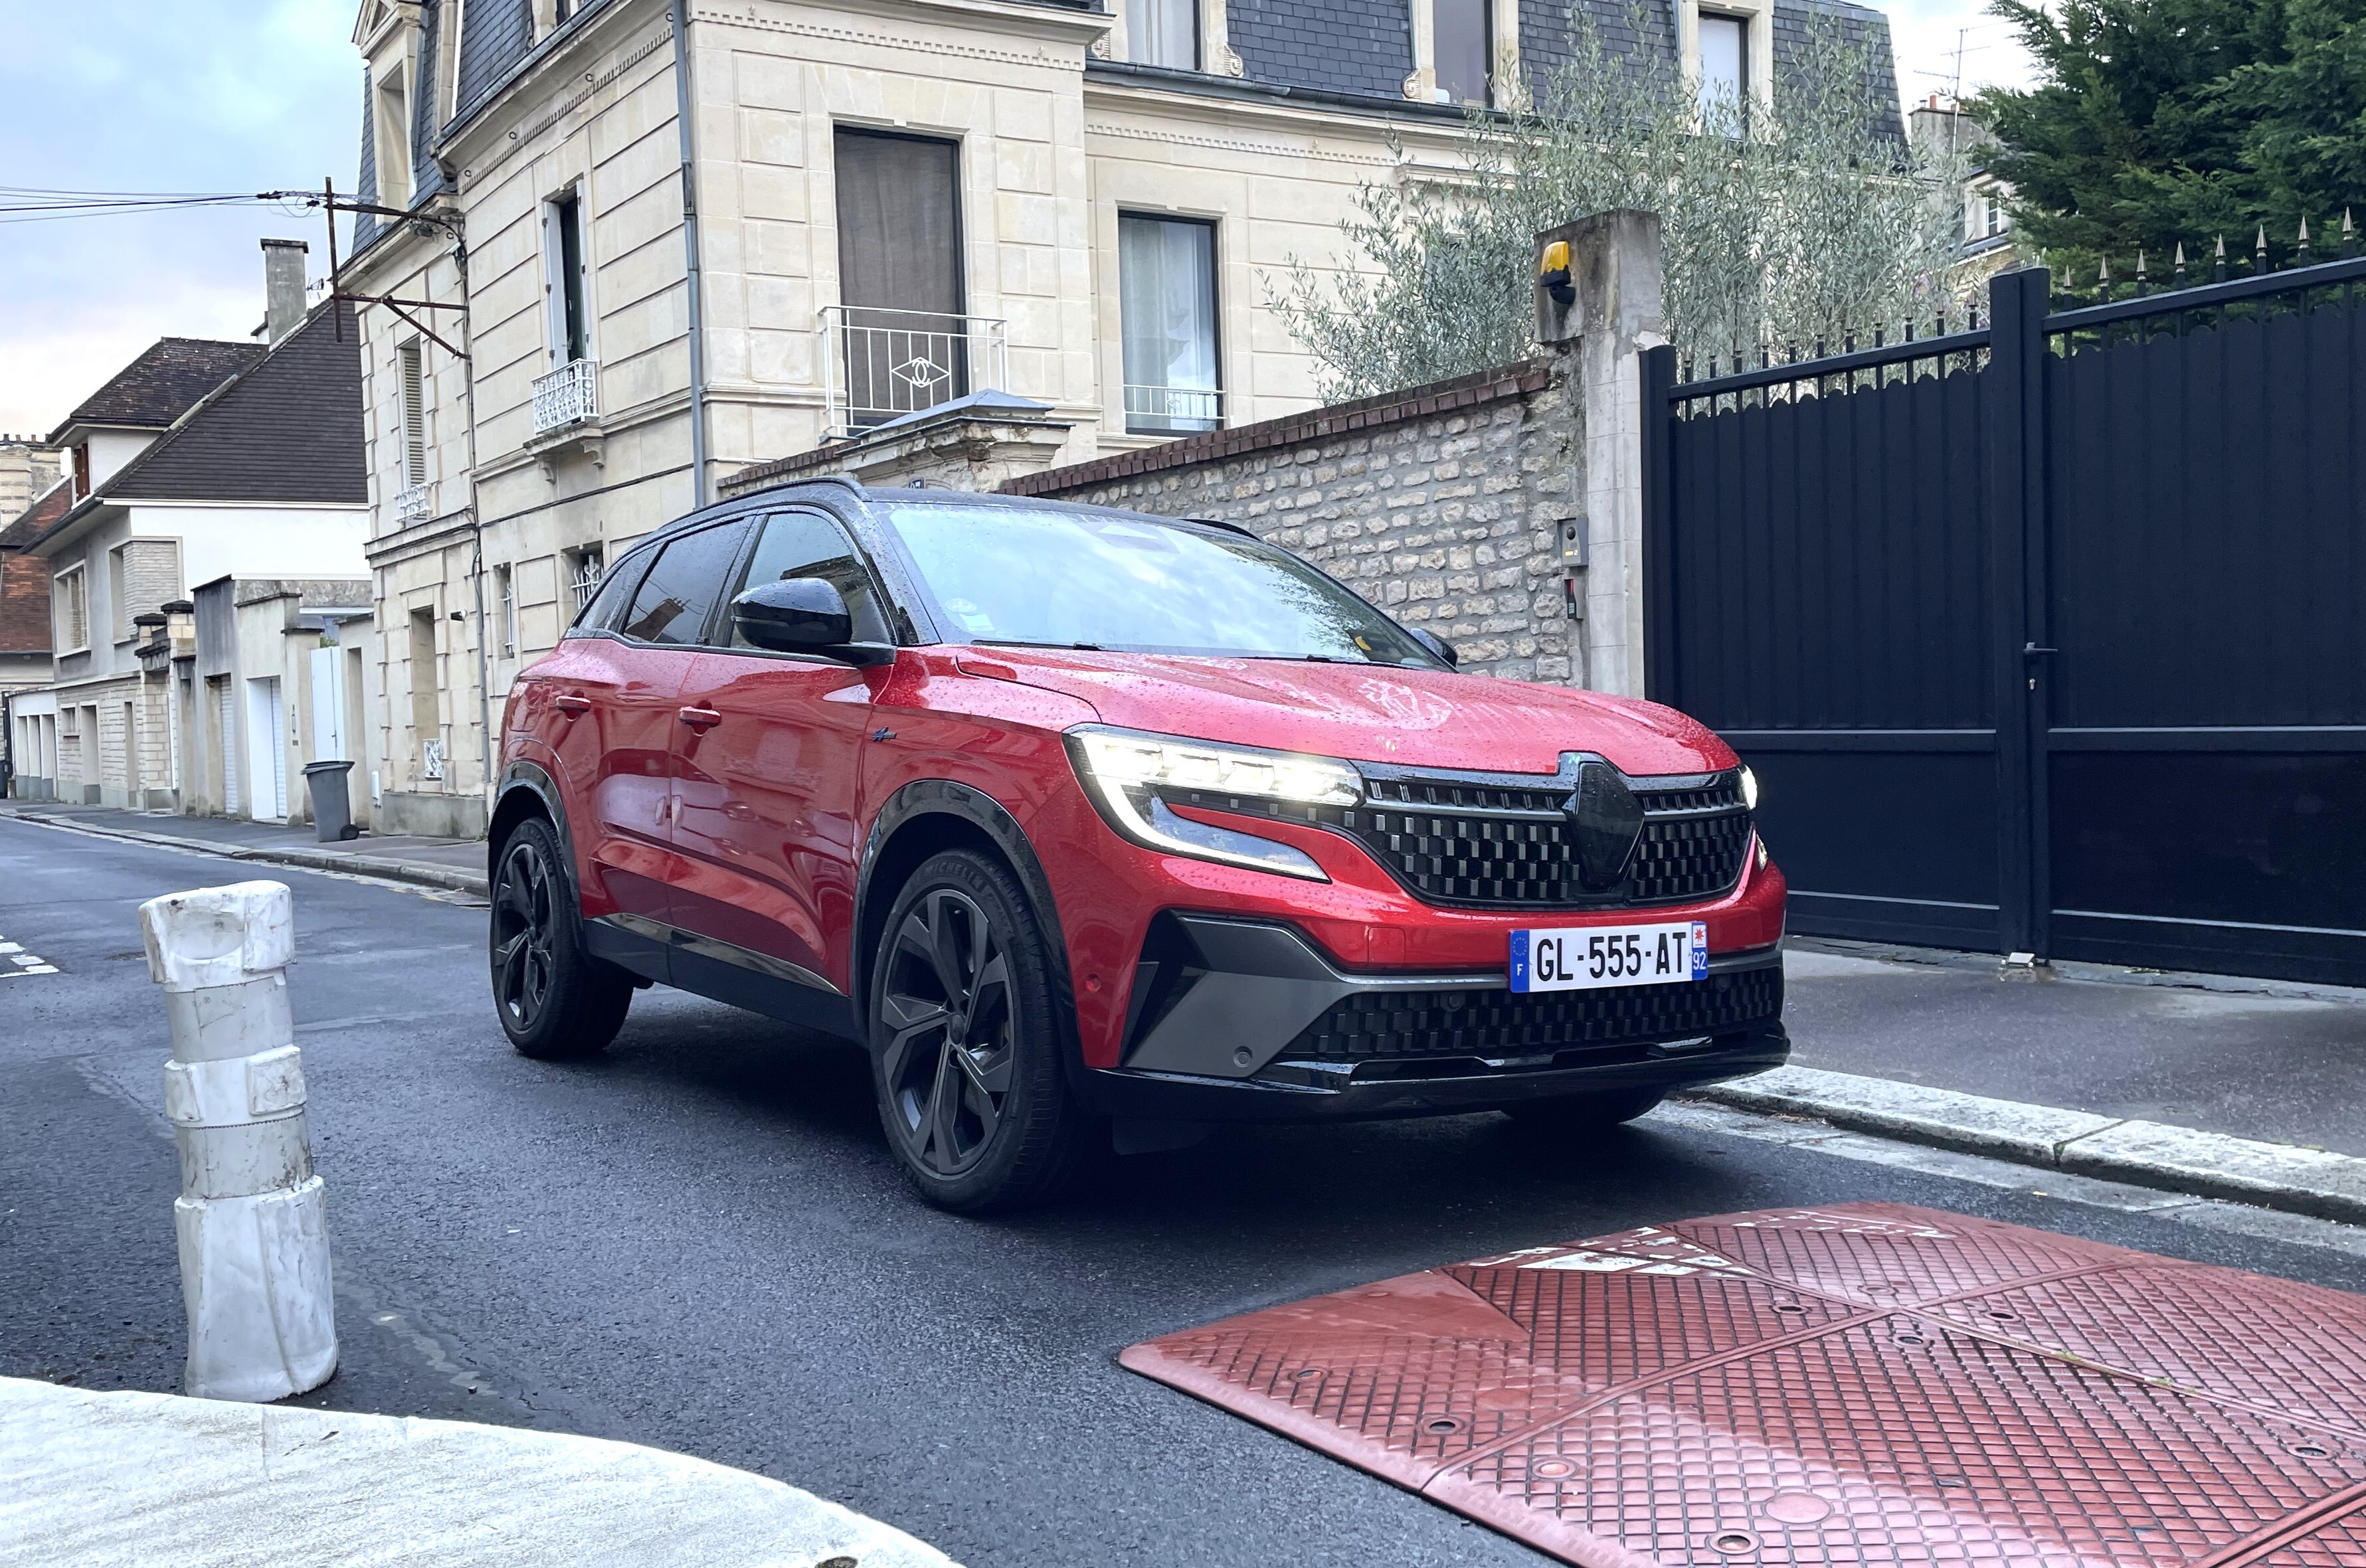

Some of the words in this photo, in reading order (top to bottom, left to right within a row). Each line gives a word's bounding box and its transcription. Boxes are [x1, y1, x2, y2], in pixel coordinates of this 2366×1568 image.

[1536, 931, 1686, 982] GL-555-AT
[1692, 951, 1706, 970] 92
[1516, 963, 1523, 976] F
